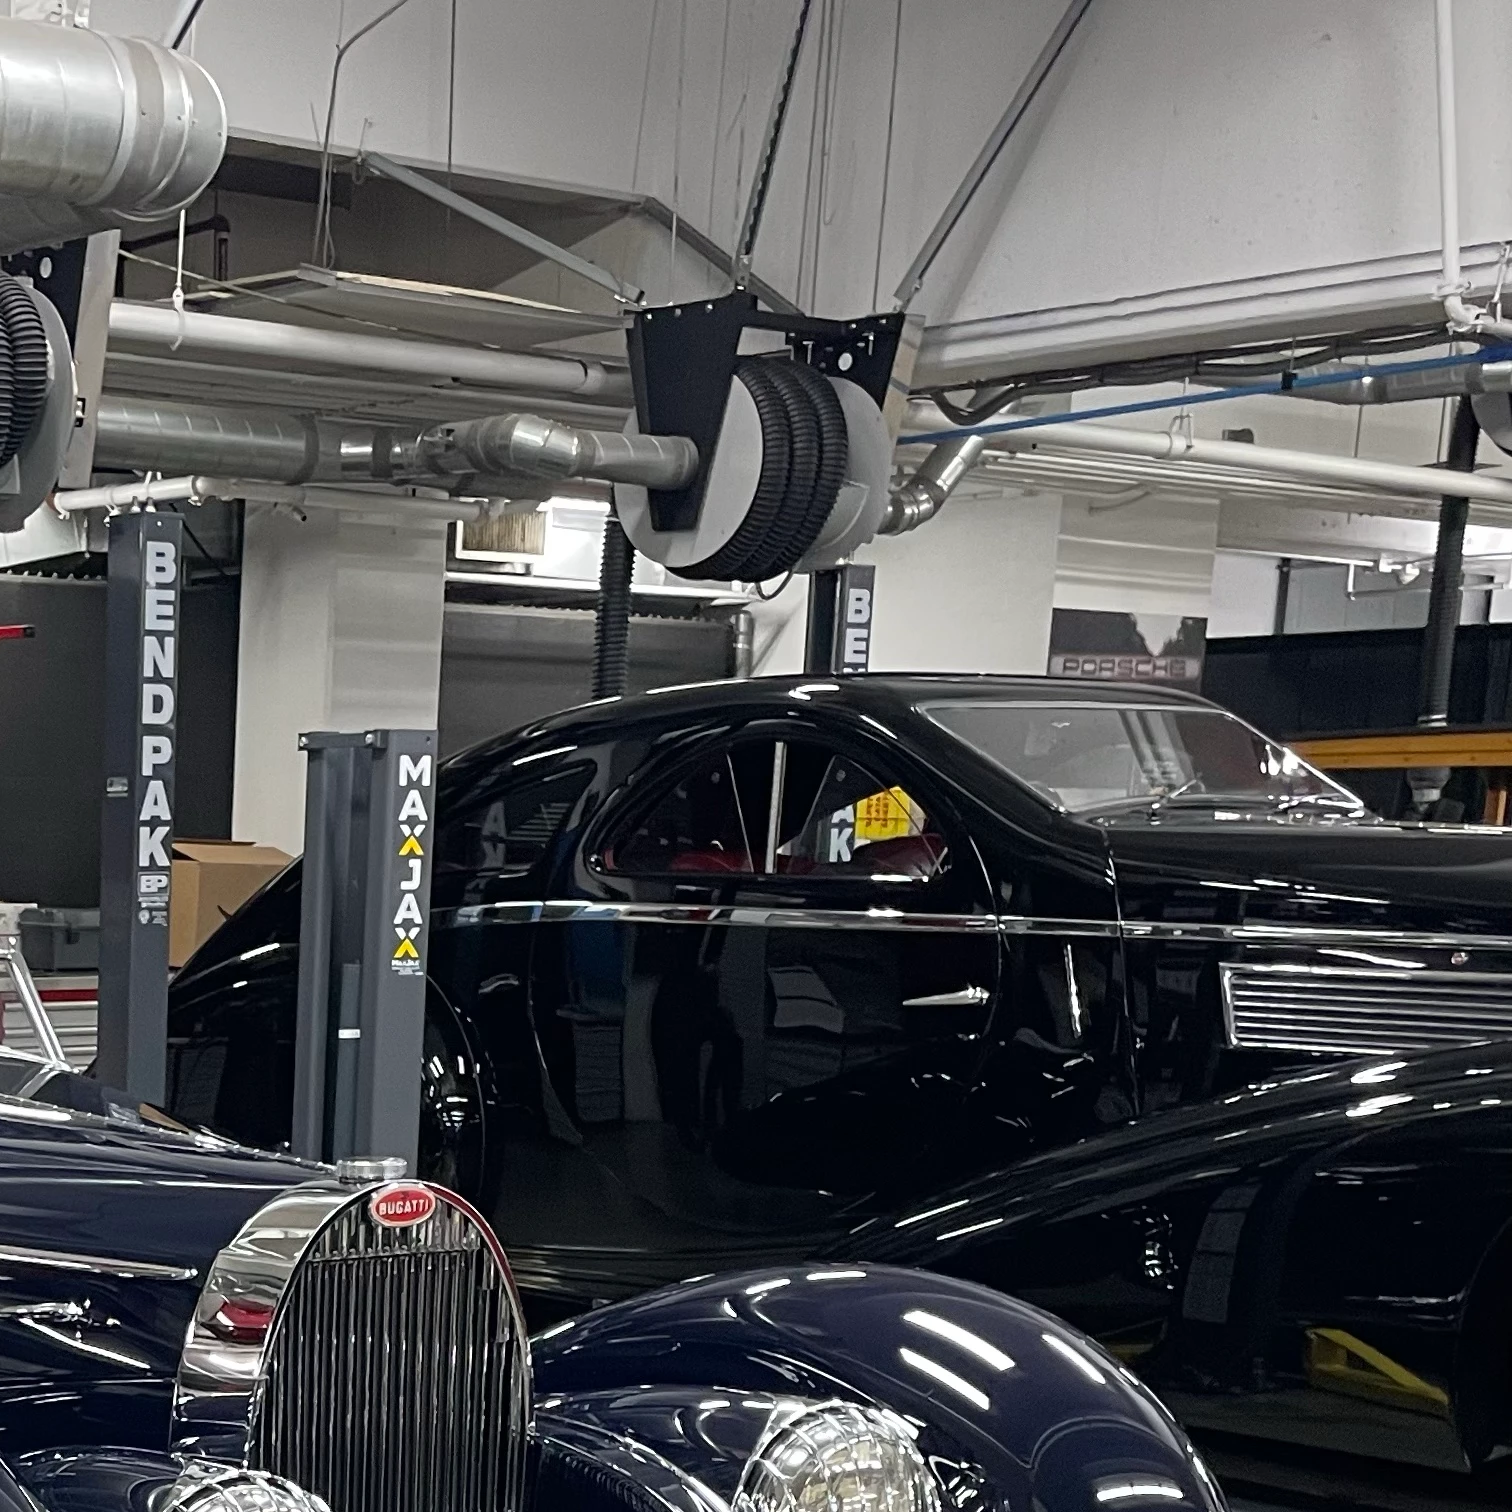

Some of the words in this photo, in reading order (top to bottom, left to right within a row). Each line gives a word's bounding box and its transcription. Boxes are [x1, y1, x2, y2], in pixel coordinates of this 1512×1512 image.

[843, 588, 870, 673] BE
[1063, 659, 1186, 678] PORSCHE
[139, 541, 176, 867] BENDPAK
[393, 754, 432, 957] MAXJAX
[379, 1200, 429, 1215] BUGATTI
